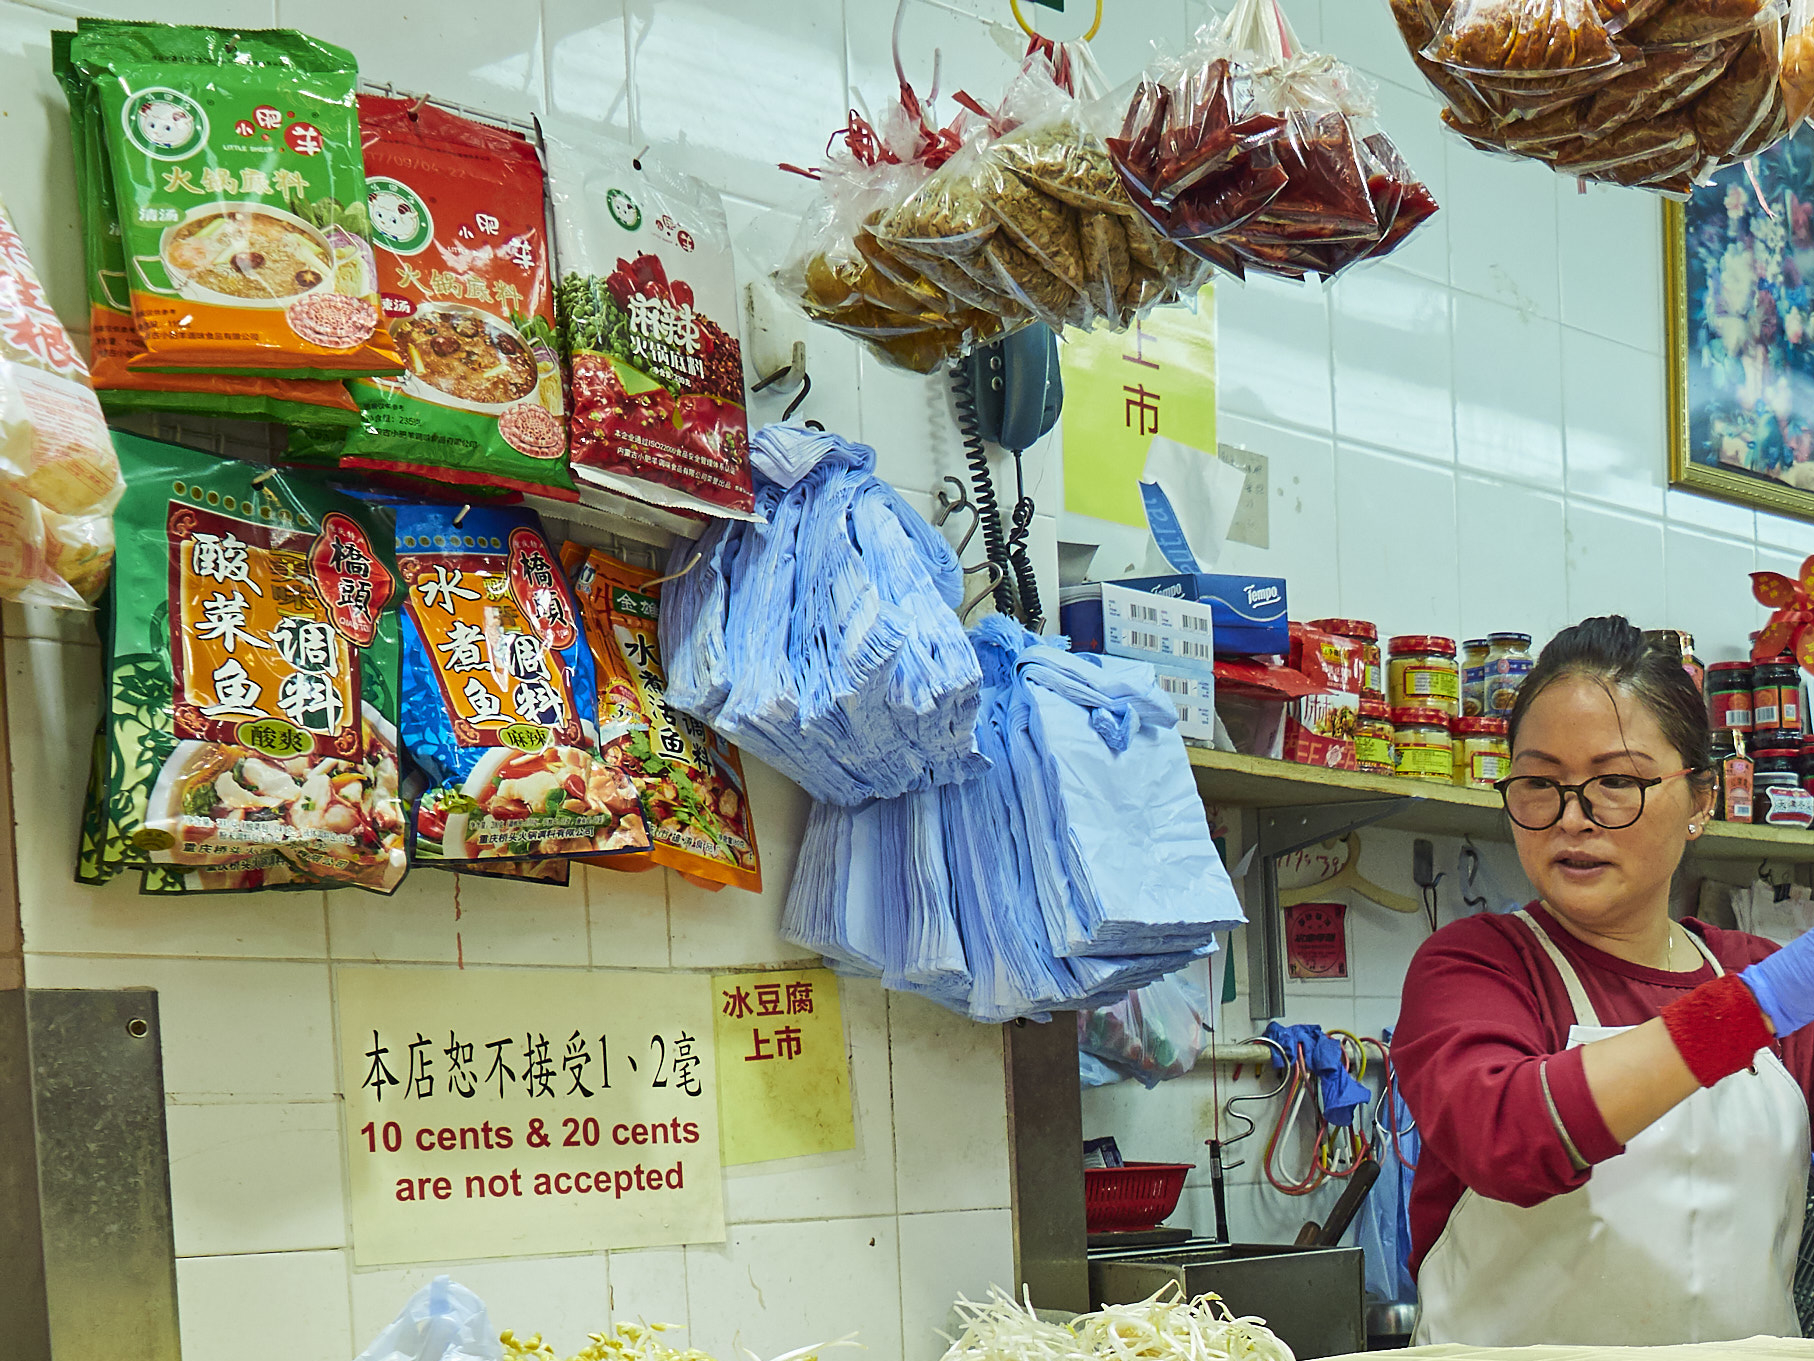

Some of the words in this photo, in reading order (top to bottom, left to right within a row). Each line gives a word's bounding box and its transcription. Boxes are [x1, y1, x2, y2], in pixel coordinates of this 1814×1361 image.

[235, 107, 320, 156] 小肥羊
[162, 166, 310, 201] 火锅底料
[138, 207, 179, 222] 清汤
[458, 212, 535, 270] 小肥羊
[396, 262, 524, 311] 火锅底料
[628, 292, 701, 354] 麻辣
[630, 335, 704, 379] 火锅底料
[330, 536, 372, 622] 橋頭
[1243, 584, 1280, 605] Tempo
[191, 532, 272, 718] 酸菜鱼
[417, 564, 517, 725] 水煮鱼
[268, 615, 344, 737] 调料
[251, 726, 303, 752] 酸爽
[508, 730, 548, 748] 麻辣
[721, 981, 814, 1019] 冰豆腐
[360, 1030, 703, 1102] 本店恕不接受1、2毫
[744, 1026, 802, 1062] 上市
[361, 1121, 402, 1153] 10
[415, 1119, 513, 1151] cents
[525, 1117, 551, 1147] &
[562, 1116, 600, 1147] 20
[611, 1116, 700, 1145] cents
[395, 1174, 452, 1201] are
[465, 1167, 522, 1197] not
[533, 1161, 684, 1199] accepted
